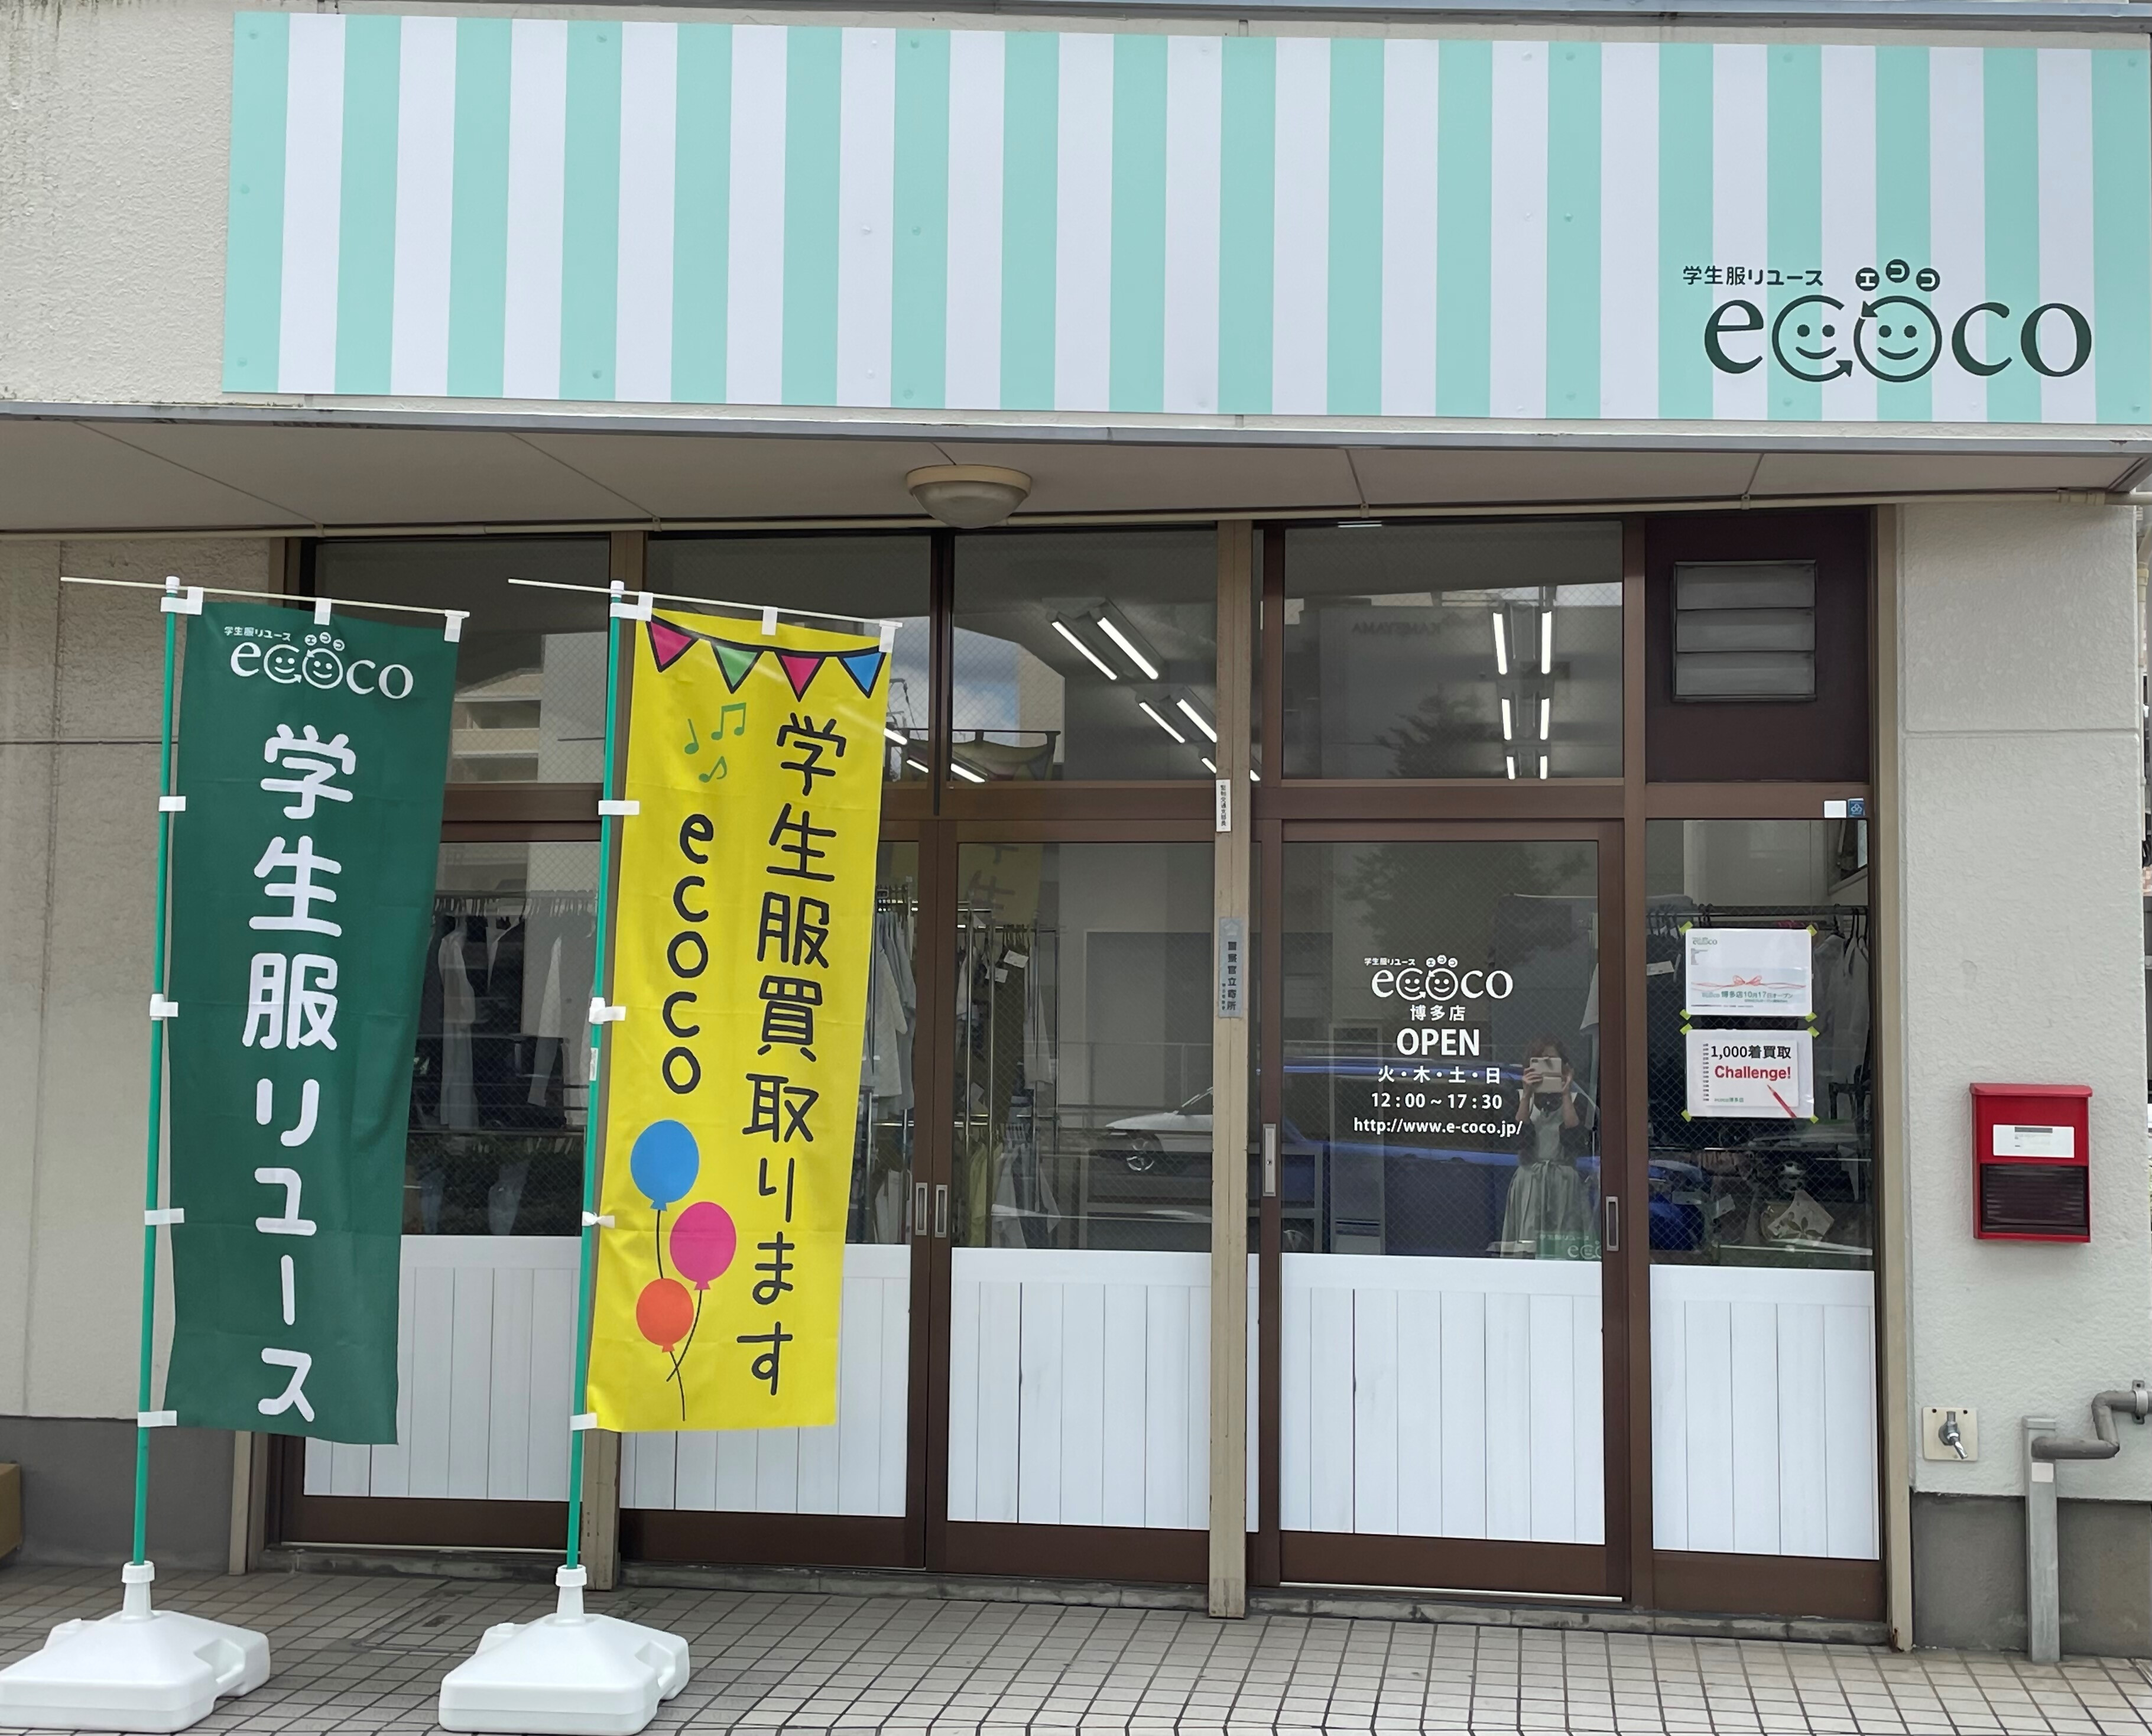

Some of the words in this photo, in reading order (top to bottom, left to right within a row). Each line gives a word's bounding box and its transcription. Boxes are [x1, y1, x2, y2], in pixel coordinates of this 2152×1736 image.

[1683, 265, 1824, 286] 学生服リユース
[1704, 294, 2092, 383] ecoco
[223, 625, 291, 642] 学生服リユース
[231, 641, 414, 699] ecoco
[662, 813, 714, 1094] ecoco
[1364, 957, 1416, 966] 学生服リユース
[1371, 968, 1514, 1001] ecoco
[1410, 1004, 1466, 1021] 博多店
[737, 712, 847, 1396] 学生服買取ります
[1396, 1028, 1480, 1056] OPEN
[1710, 1044, 1792, 1060] 1,000着買取
[242, 723, 356, 1422] 学生服リユース
[1714, 1065, 1791, 1081] Challenge!
[1353, 1117, 1523, 1137] http://www.e-coco.jp/
